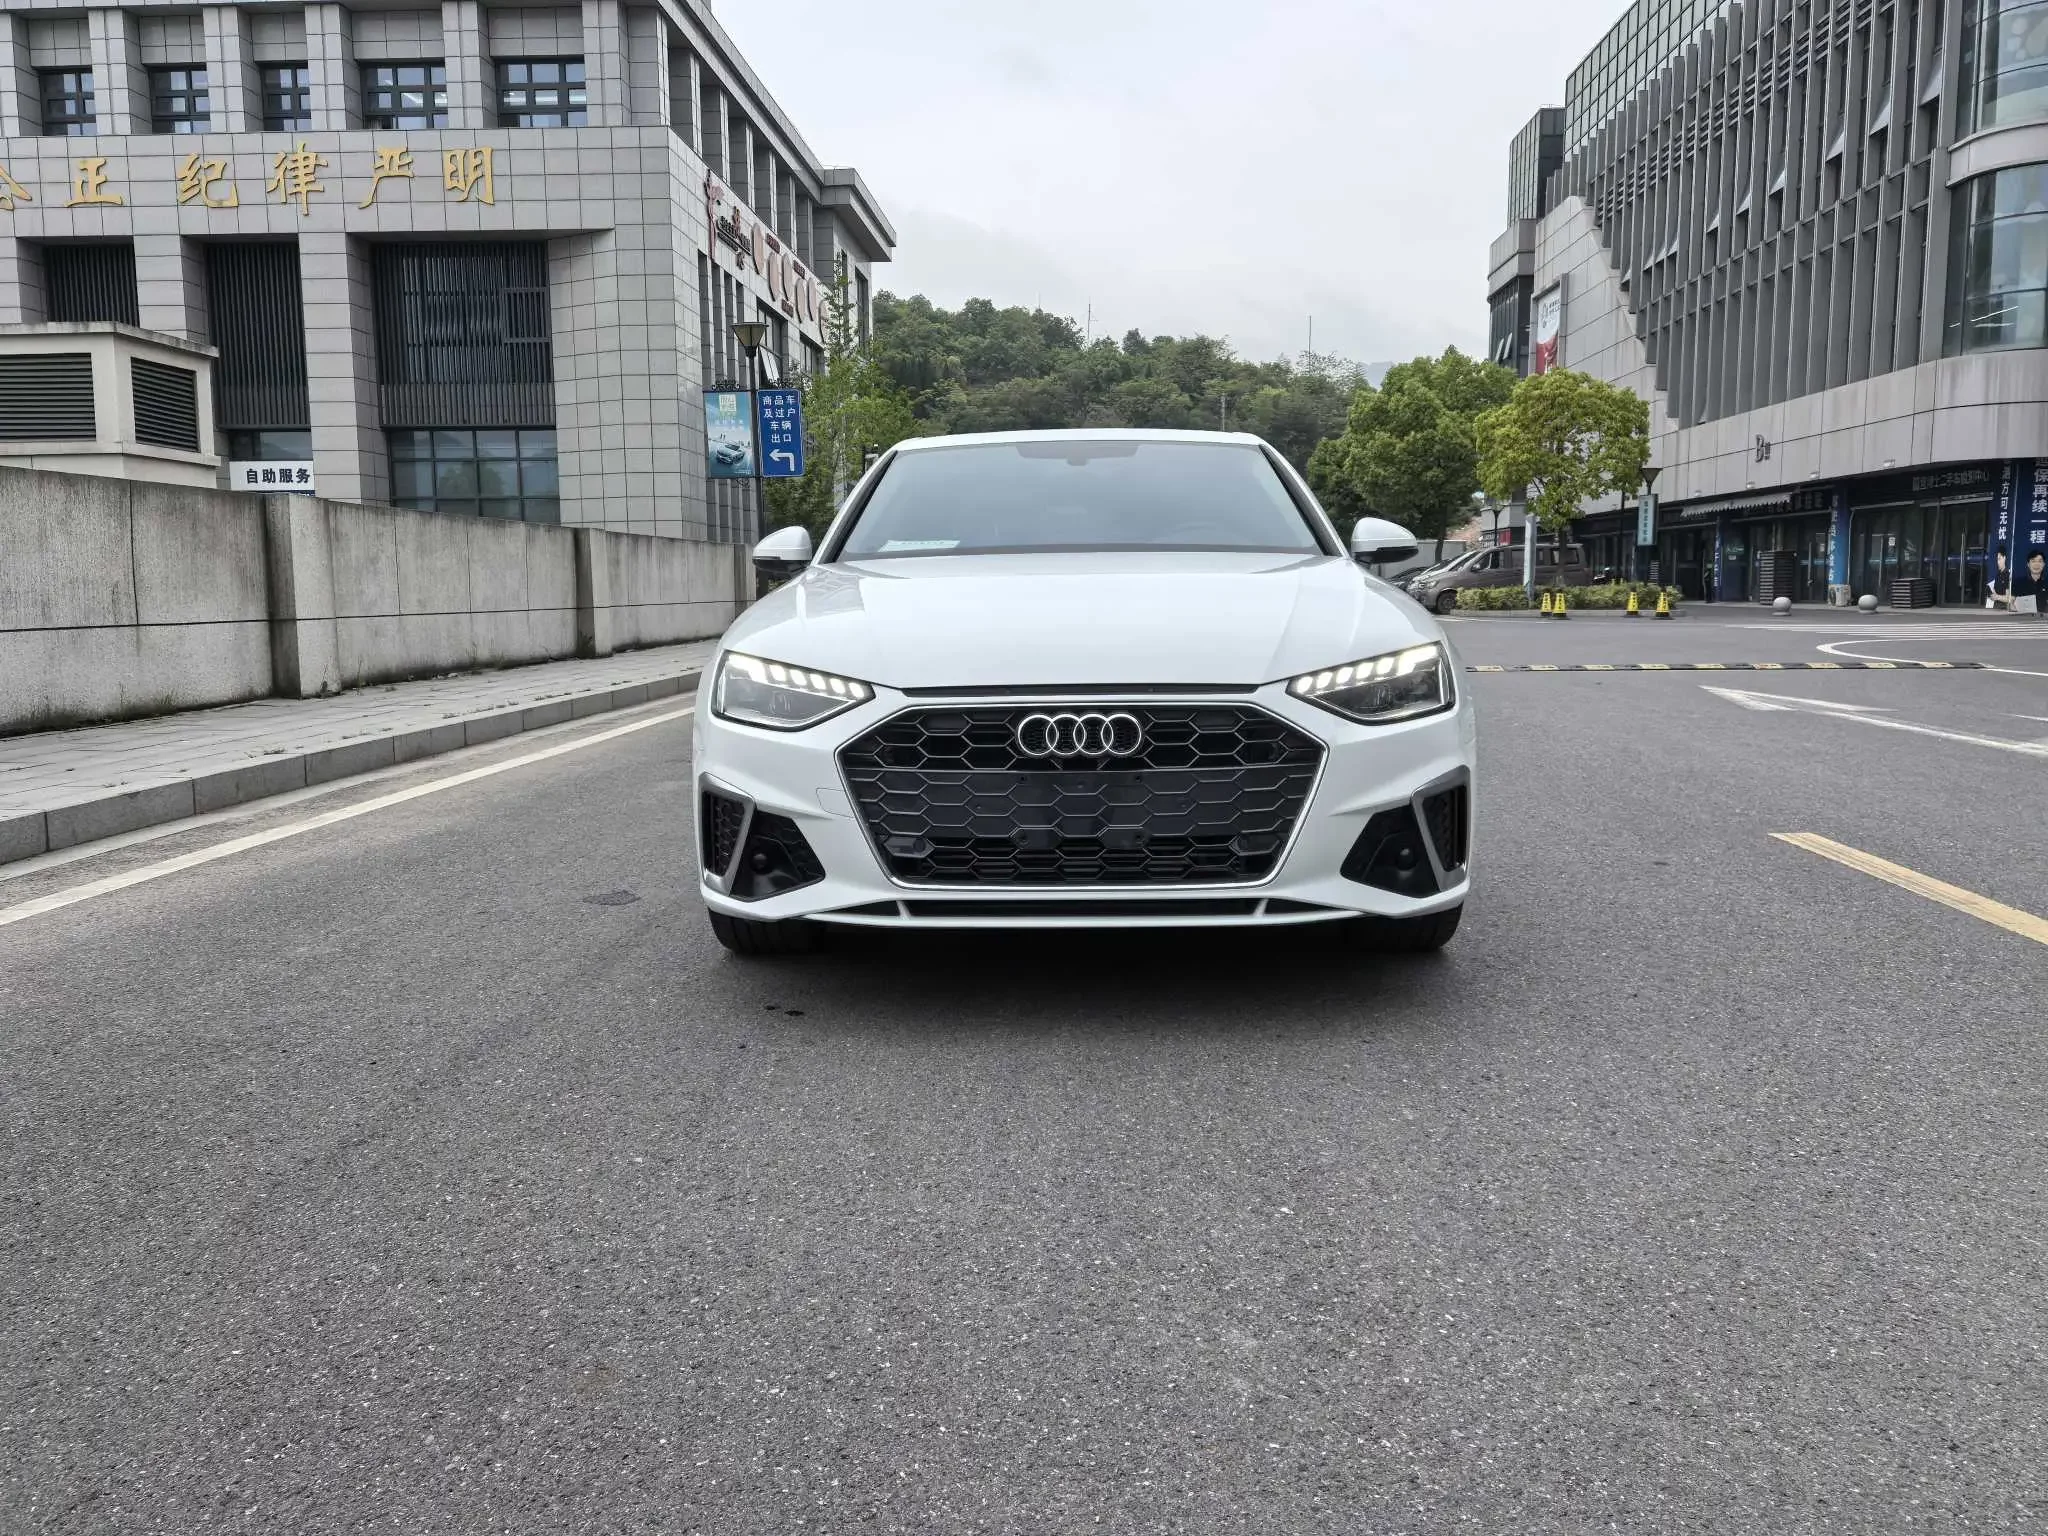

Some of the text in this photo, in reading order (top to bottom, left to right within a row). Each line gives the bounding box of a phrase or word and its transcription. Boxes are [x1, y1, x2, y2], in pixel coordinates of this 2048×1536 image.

[178, 142, 496, 216] 纪律严明
[762, 395, 797, 406] 商品车
[763, 408, 796, 418] 及过户
[770, 421, 792, 431] 车辆
[771, 434, 792, 443] 出口
[246, 468, 311, 484] 自助服务
[1998, 459, 2011, 540] 方可无忧
